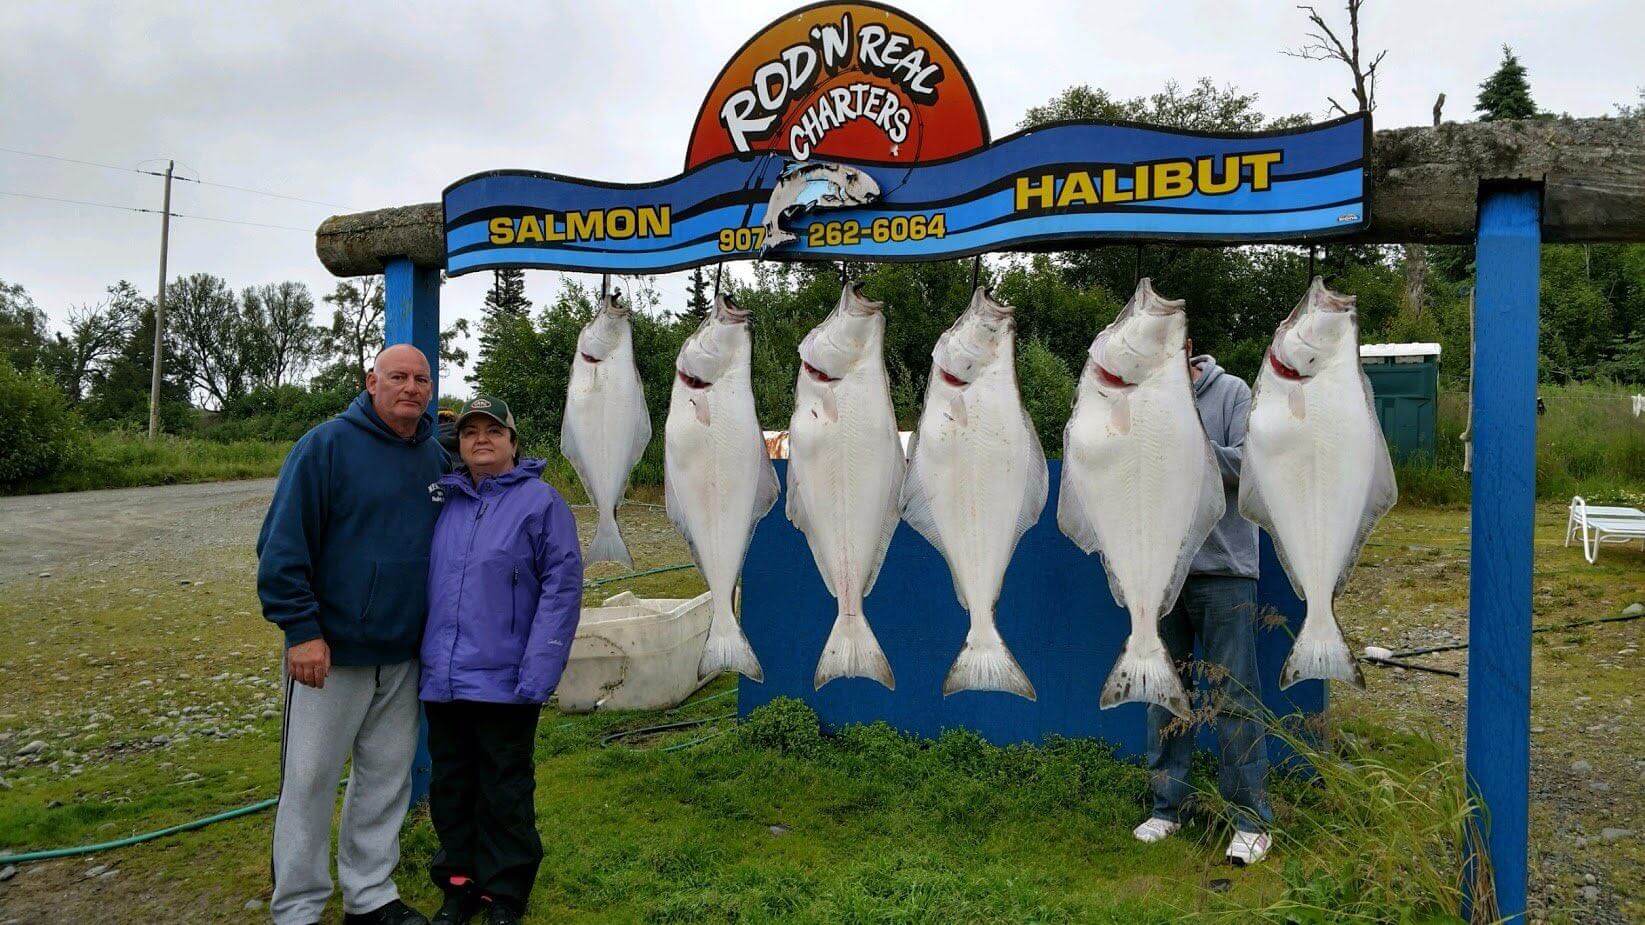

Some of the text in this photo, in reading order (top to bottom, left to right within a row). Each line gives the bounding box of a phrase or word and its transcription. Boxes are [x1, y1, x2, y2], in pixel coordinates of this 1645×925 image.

[859, 24, 942, 96] REAL
[789, 83, 911, 161] CHARTERS
[1015, 151, 1282, 211] HALIBUT
[489, 206, 671, 245] SALMON
[719, 214, 946, 253] 907 262-6064
